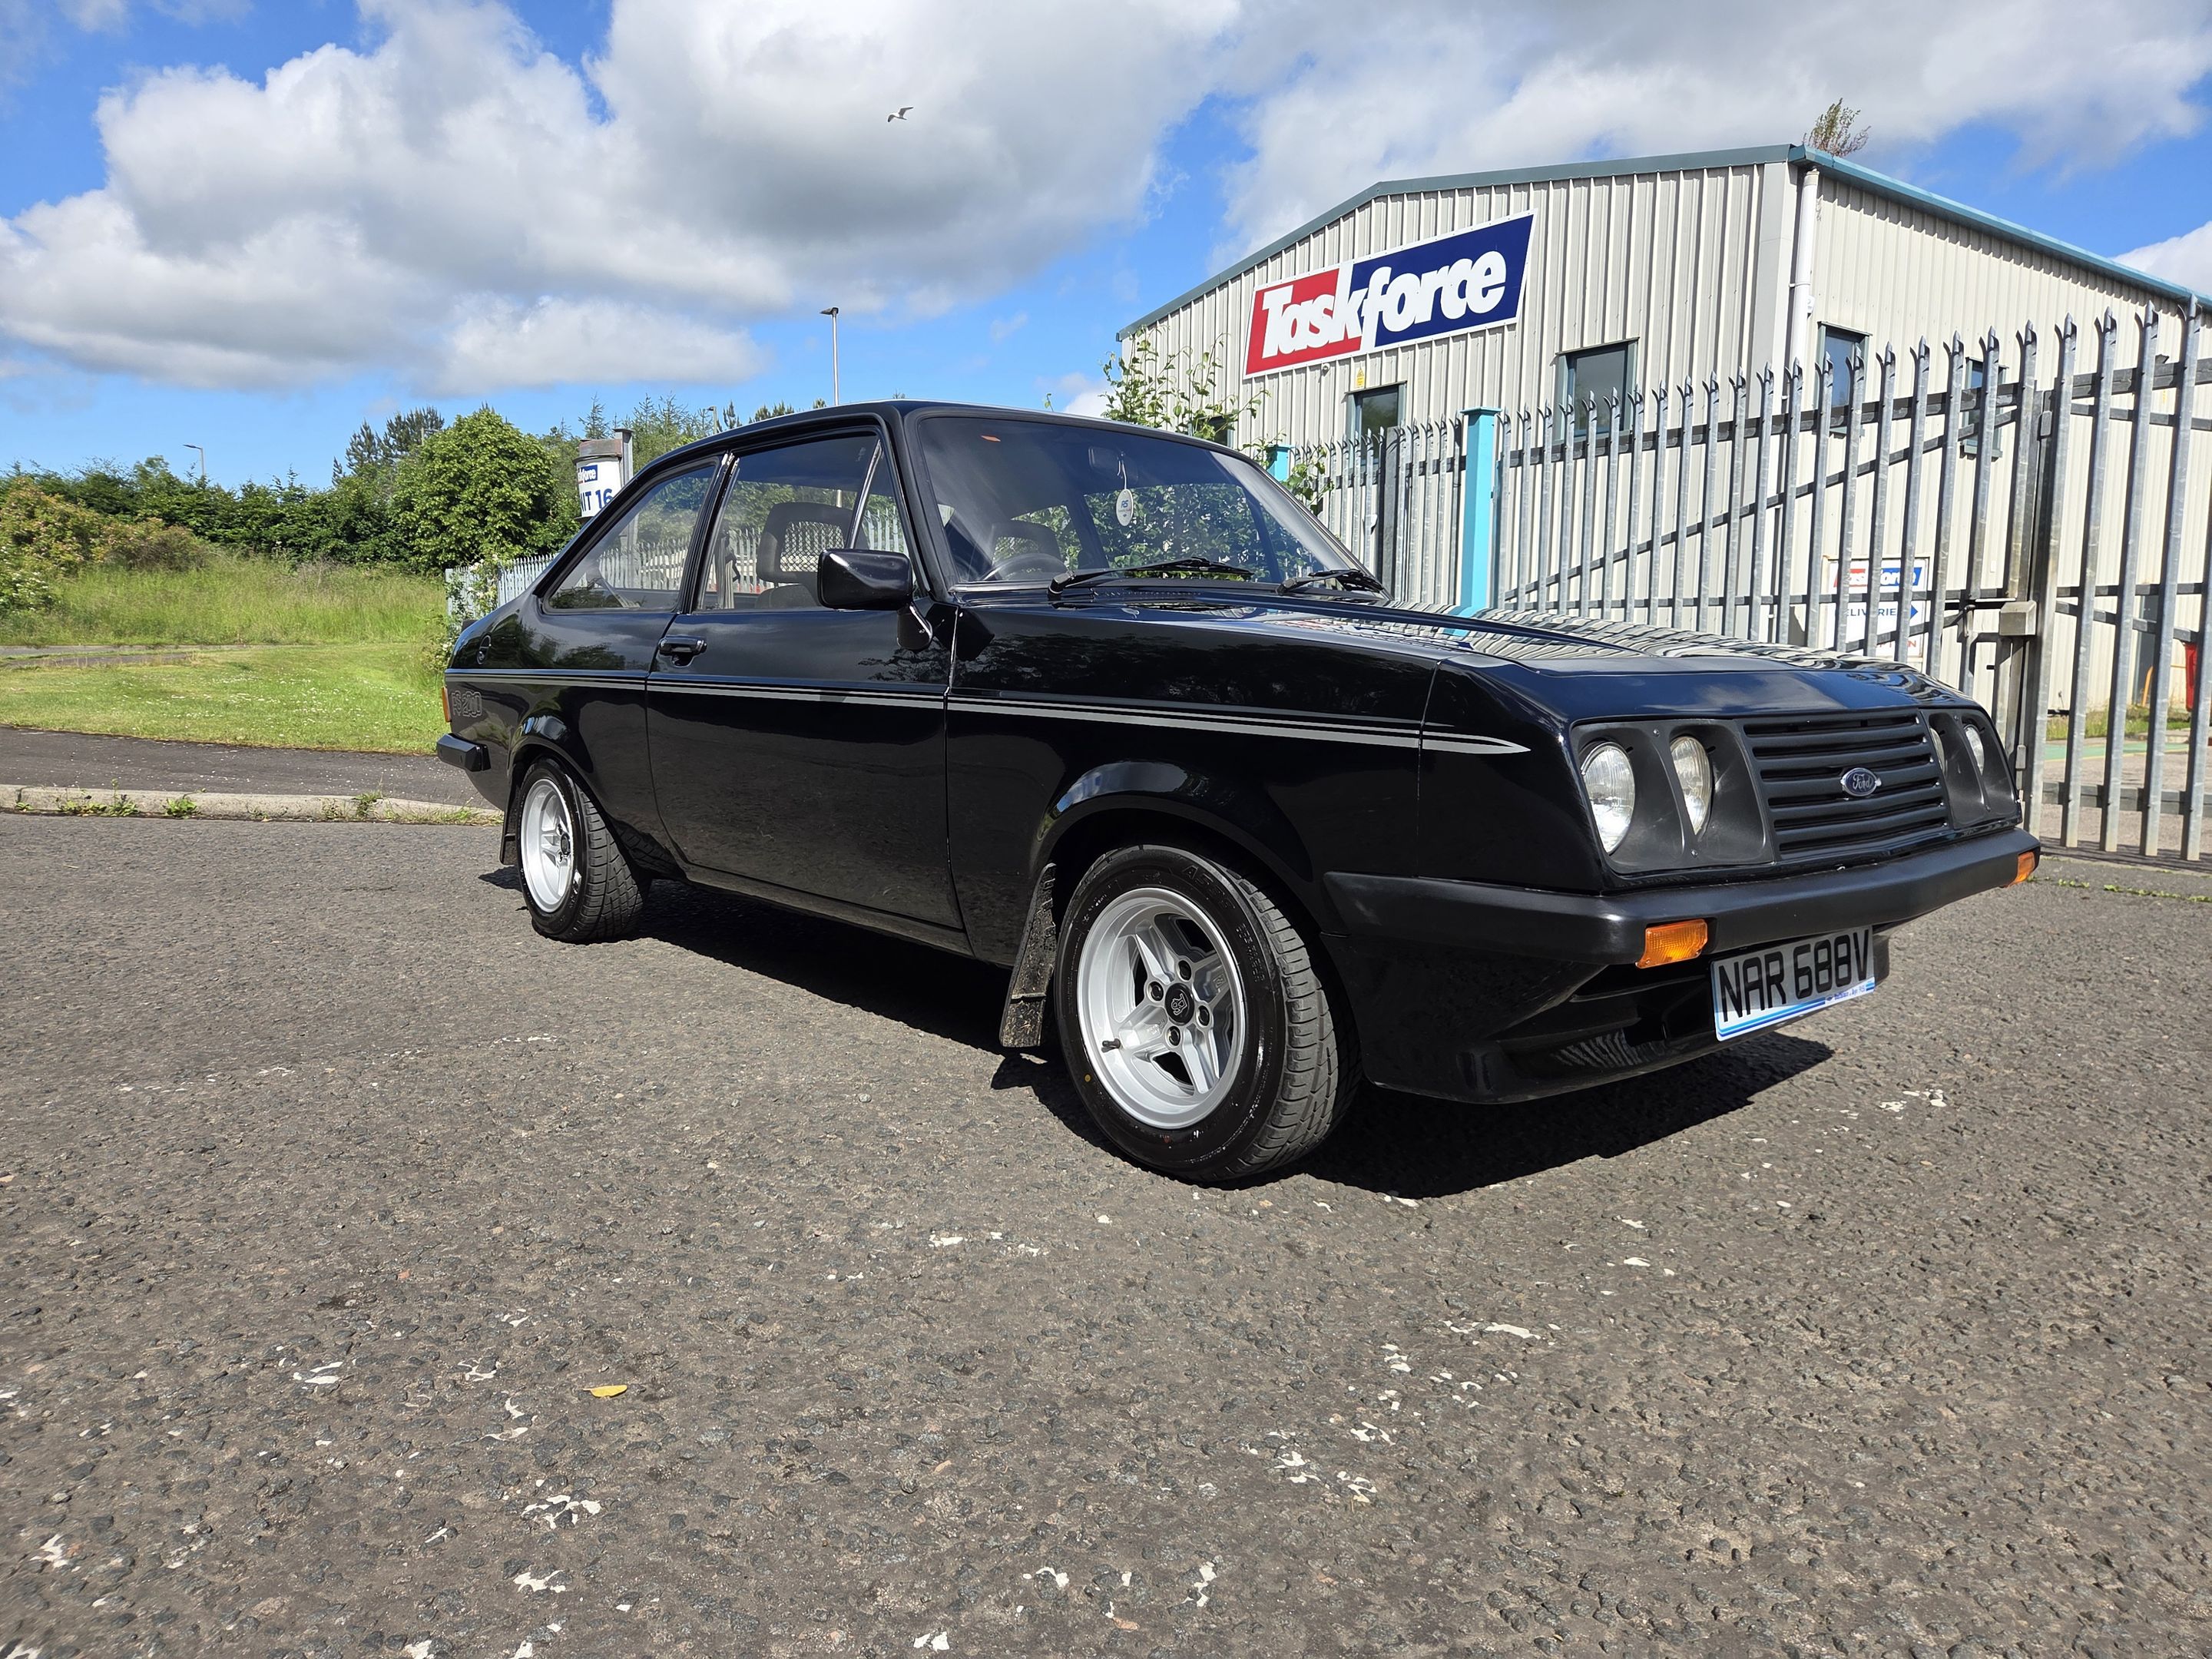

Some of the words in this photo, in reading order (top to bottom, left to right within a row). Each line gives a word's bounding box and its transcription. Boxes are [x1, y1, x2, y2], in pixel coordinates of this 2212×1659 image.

[1261, 250, 1507, 359] Taskforce
[1852, 773, 1874, 791] Ford
[1718, 951, 1786, 1022] NAR
[1793, 929, 1869, 999] 688V
